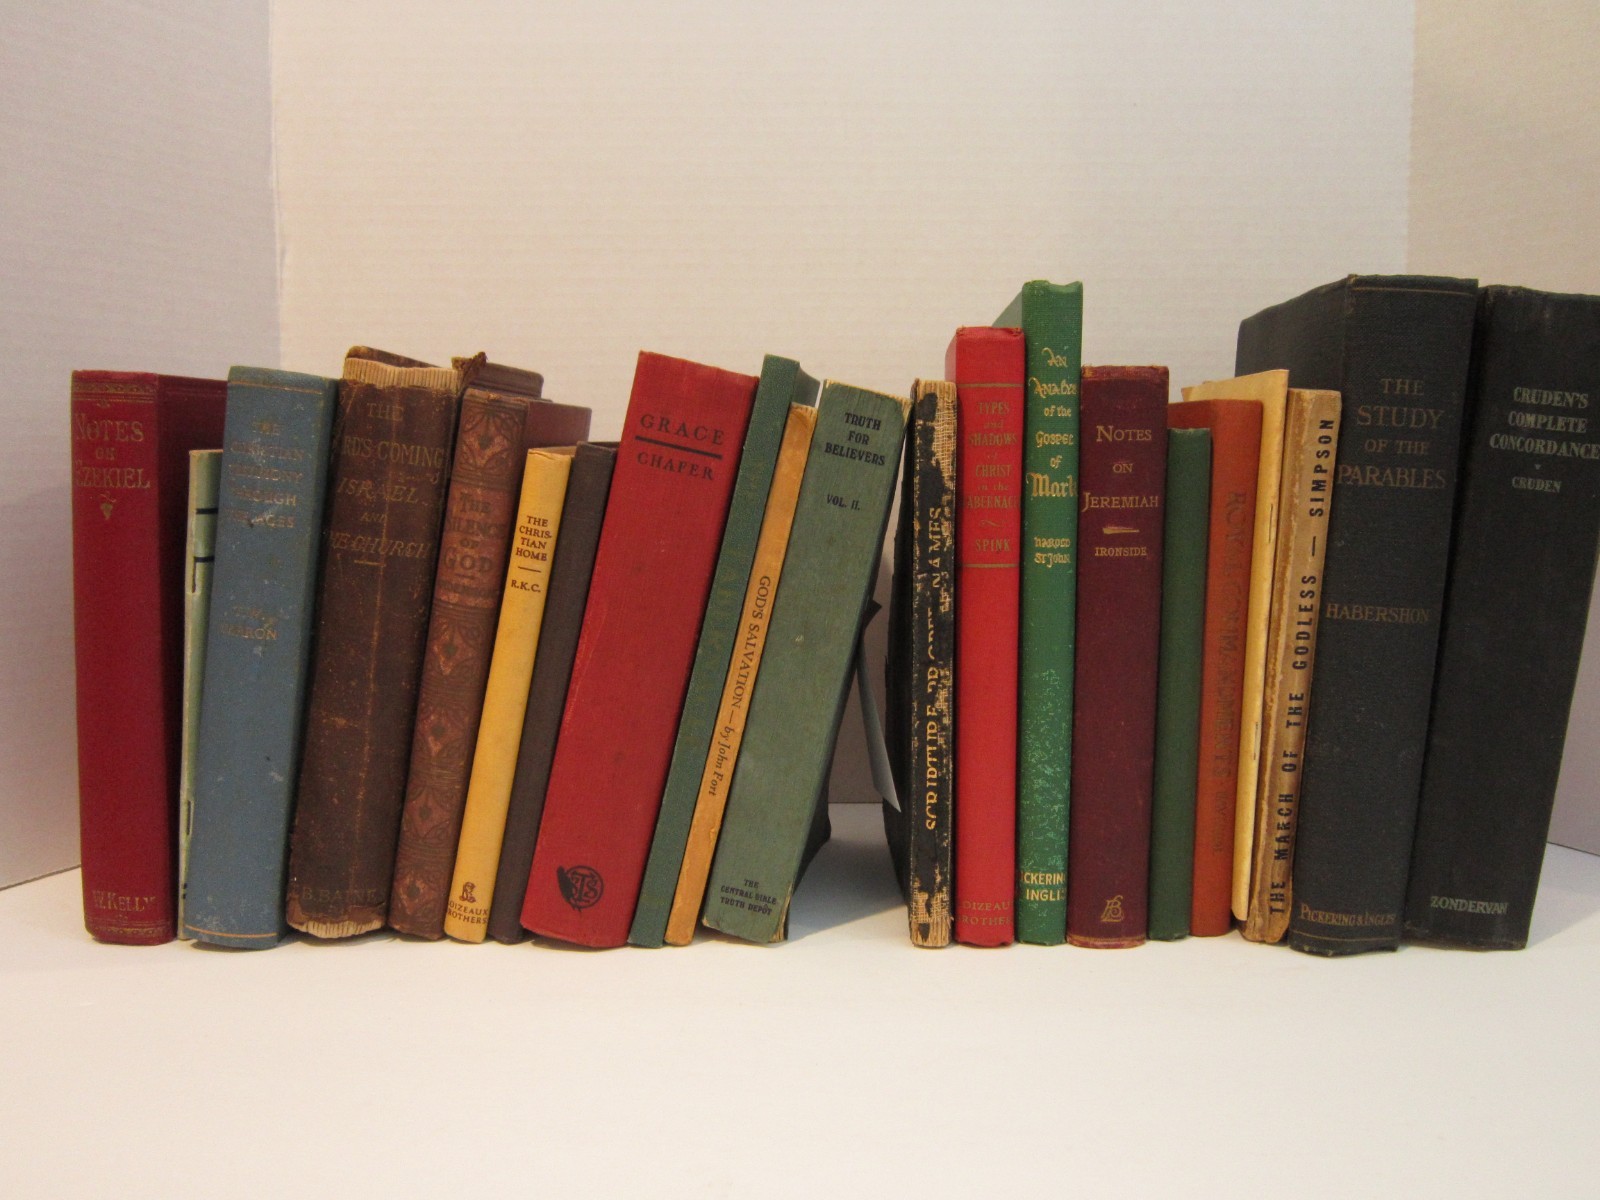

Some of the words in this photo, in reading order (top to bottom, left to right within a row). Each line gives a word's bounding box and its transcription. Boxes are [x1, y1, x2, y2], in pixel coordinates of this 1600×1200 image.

[1380, 378, 1425, 397] THE
[1512, 386, 1589, 409] CRUDEN'S
[367, 402, 404, 422] THE
[977, 402, 1010, 415] TYPES
[1043, 404, 1056, 417] of
[1057, 404, 1072, 417] the
[1356, 405, 1445, 429] STUDY
[74, 412, 144, 443] NOTES
[639, 413, 726, 446] GRACE
[844, 412, 882, 433] TRUTH
[1507, 410, 1588, 434] COMPLETE
[848, 429, 870, 447] FOR
[967, 432, 1018, 448] SHADOWS
[1096, 425, 1152, 443] NOTES
[377, 440, 445, 468] COMING
[824, 443, 886, 468] BELIEVERS
[1364, 438, 1385, 453] OF
[1395, 439, 1430, 455] THE
[1488, 433, 1600, 461] CONCORDANCE
[636, 451, 715, 481] CHAFER
[975, 463, 1012, 478] CHRIST
[1049, 454, 1063, 469] of
[1113, 463, 1133, 474] ON
[1309, 419, 1335, 517] SIMPSON
[1337, 464, 1447, 490] PARABLES
[1511, 475, 1562, 493] CRUDEN
[337, 477, 420, 505] ISRAEL
[825, 493, 848, 510] VOL.
[1081, 492, 1159, 513] JEREMIAH
[526, 515, 549, 528] THE
[518, 525, 552, 540] CHRIS-
[520, 537, 547, 550] TIAN
[928, 507, 942, 589] NAMES
[974, 538, 1011, 553] SPINK
[1094, 547, 1148, 558] IRONSIDE
[444, 546, 493, 573] GOD
[515, 547, 548, 562] HOME
[510, 579, 541, 593] R.K.C.
[752, 575, 771, 620] GOD'S
[1292, 575, 1317, 671] GODLESS
[1325, 602, 1430, 625] HABERSHON
[732, 623, 760, 708] SALVATION
[1286, 693, 1304, 729] THE
[720, 726, 735, 741] by
[714, 741, 731, 769] John
[1281, 751, 1299, 773] OF
[708, 771, 724, 796] Fort
[1274, 793, 1294, 861] MARCH
[744, 879, 760, 889] THE
[720, 885, 753, 899] CENTRAL
[754, 894, 777, 905] BIBLE
[720, 896, 745, 909] TRUTH
[1270, 880, 1286, 915] THE
[1430, 895, 1509, 915] ZONDERVAN
[447, 910, 488, 926] ROTHERS
